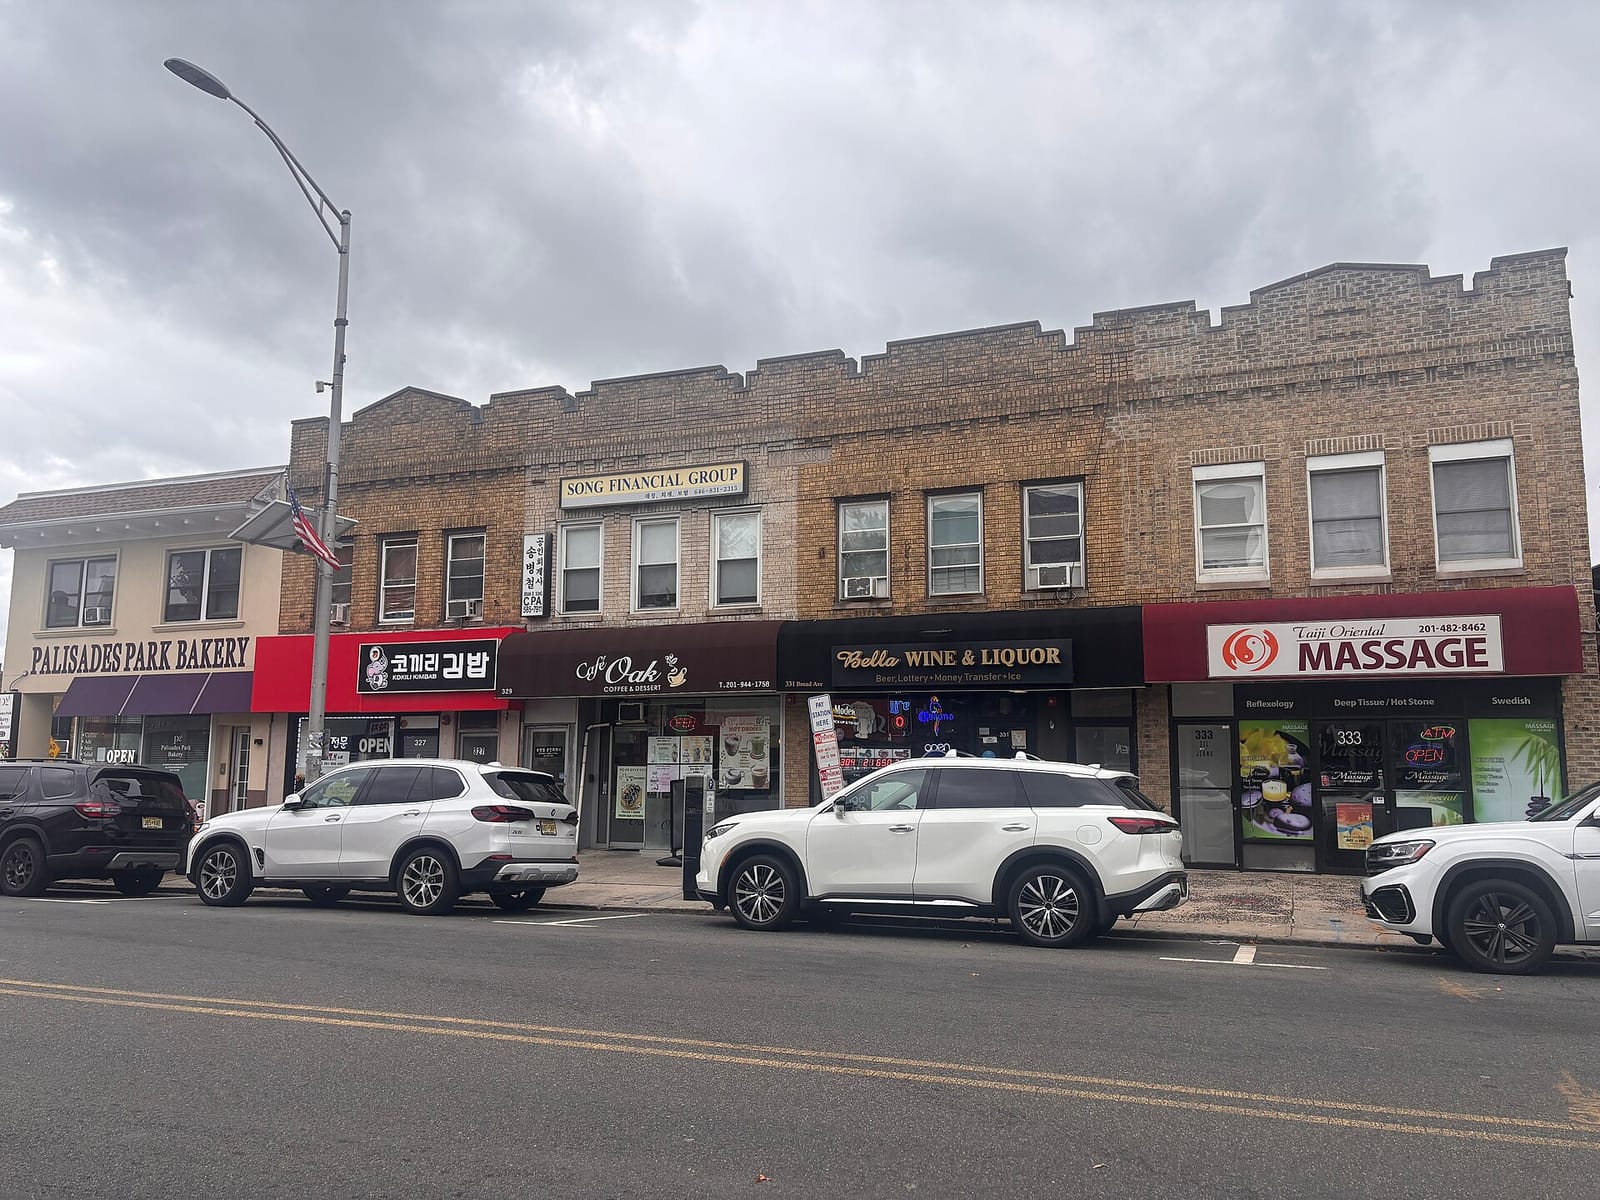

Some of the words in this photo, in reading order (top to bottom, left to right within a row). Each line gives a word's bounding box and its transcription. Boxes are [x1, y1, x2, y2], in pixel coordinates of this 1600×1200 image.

[567, 480, 604, 496] SONG
[609, 472, 683, 492] FINANCIAL
[688, 467, 738, 485] GROUP
[523, 596, 542, 606] CPA
[1292, 625, 1327, 640] Taiji
[1329, 623, 1386, 638] Oriental
[1418, 622, 1487, 634] 201-482-8462
[30, 643, 123, 676] PALISADES
[123, 640, 173, 672] PARK
[175, 637, 250, 669] BAKERY
[836, 650, 901, 669] Bella
[904, 650, 958, 668] WINE
[961, 649, 976, 666] &
[981, 647, 1062, 668] LIQUOR
[1298, 637, 1489, 672] MASSAGE
[390, 653, 440, 673] 코끼리
[443, 651, 490, 679] 김밥
[604, 656, 663, 684] Oak
[964, 672, 1000, 682] Transfer
[635, 684, 662, 692] DESSERT
[815, 701, 824, 709] PAY
[1246, 699, 1295, 709] Reflexology
[1334, 698, 1357, 708] Deep
[1358, 697, 1384, 706] Tissue
[1391, 697, 1406, 706] Hot
[1408, 696, 1435, 706] Stone
[1491, 695, 1531, 706] Swedish
[811, 709, 831, 719] STATION
[1195, 730, 1214, 740] 333
[1337, 730, 1362, 745] 333
[1424, 727, 1454, 739] ATM
[330, 736, 348, 750] 전문
[358, 738, 392, 753] OPEN
[106, 749, 136, 764] OPEN
[1405, 749, 1444, 763] OPEN
[1405, 771, 1449, 782] Massage
